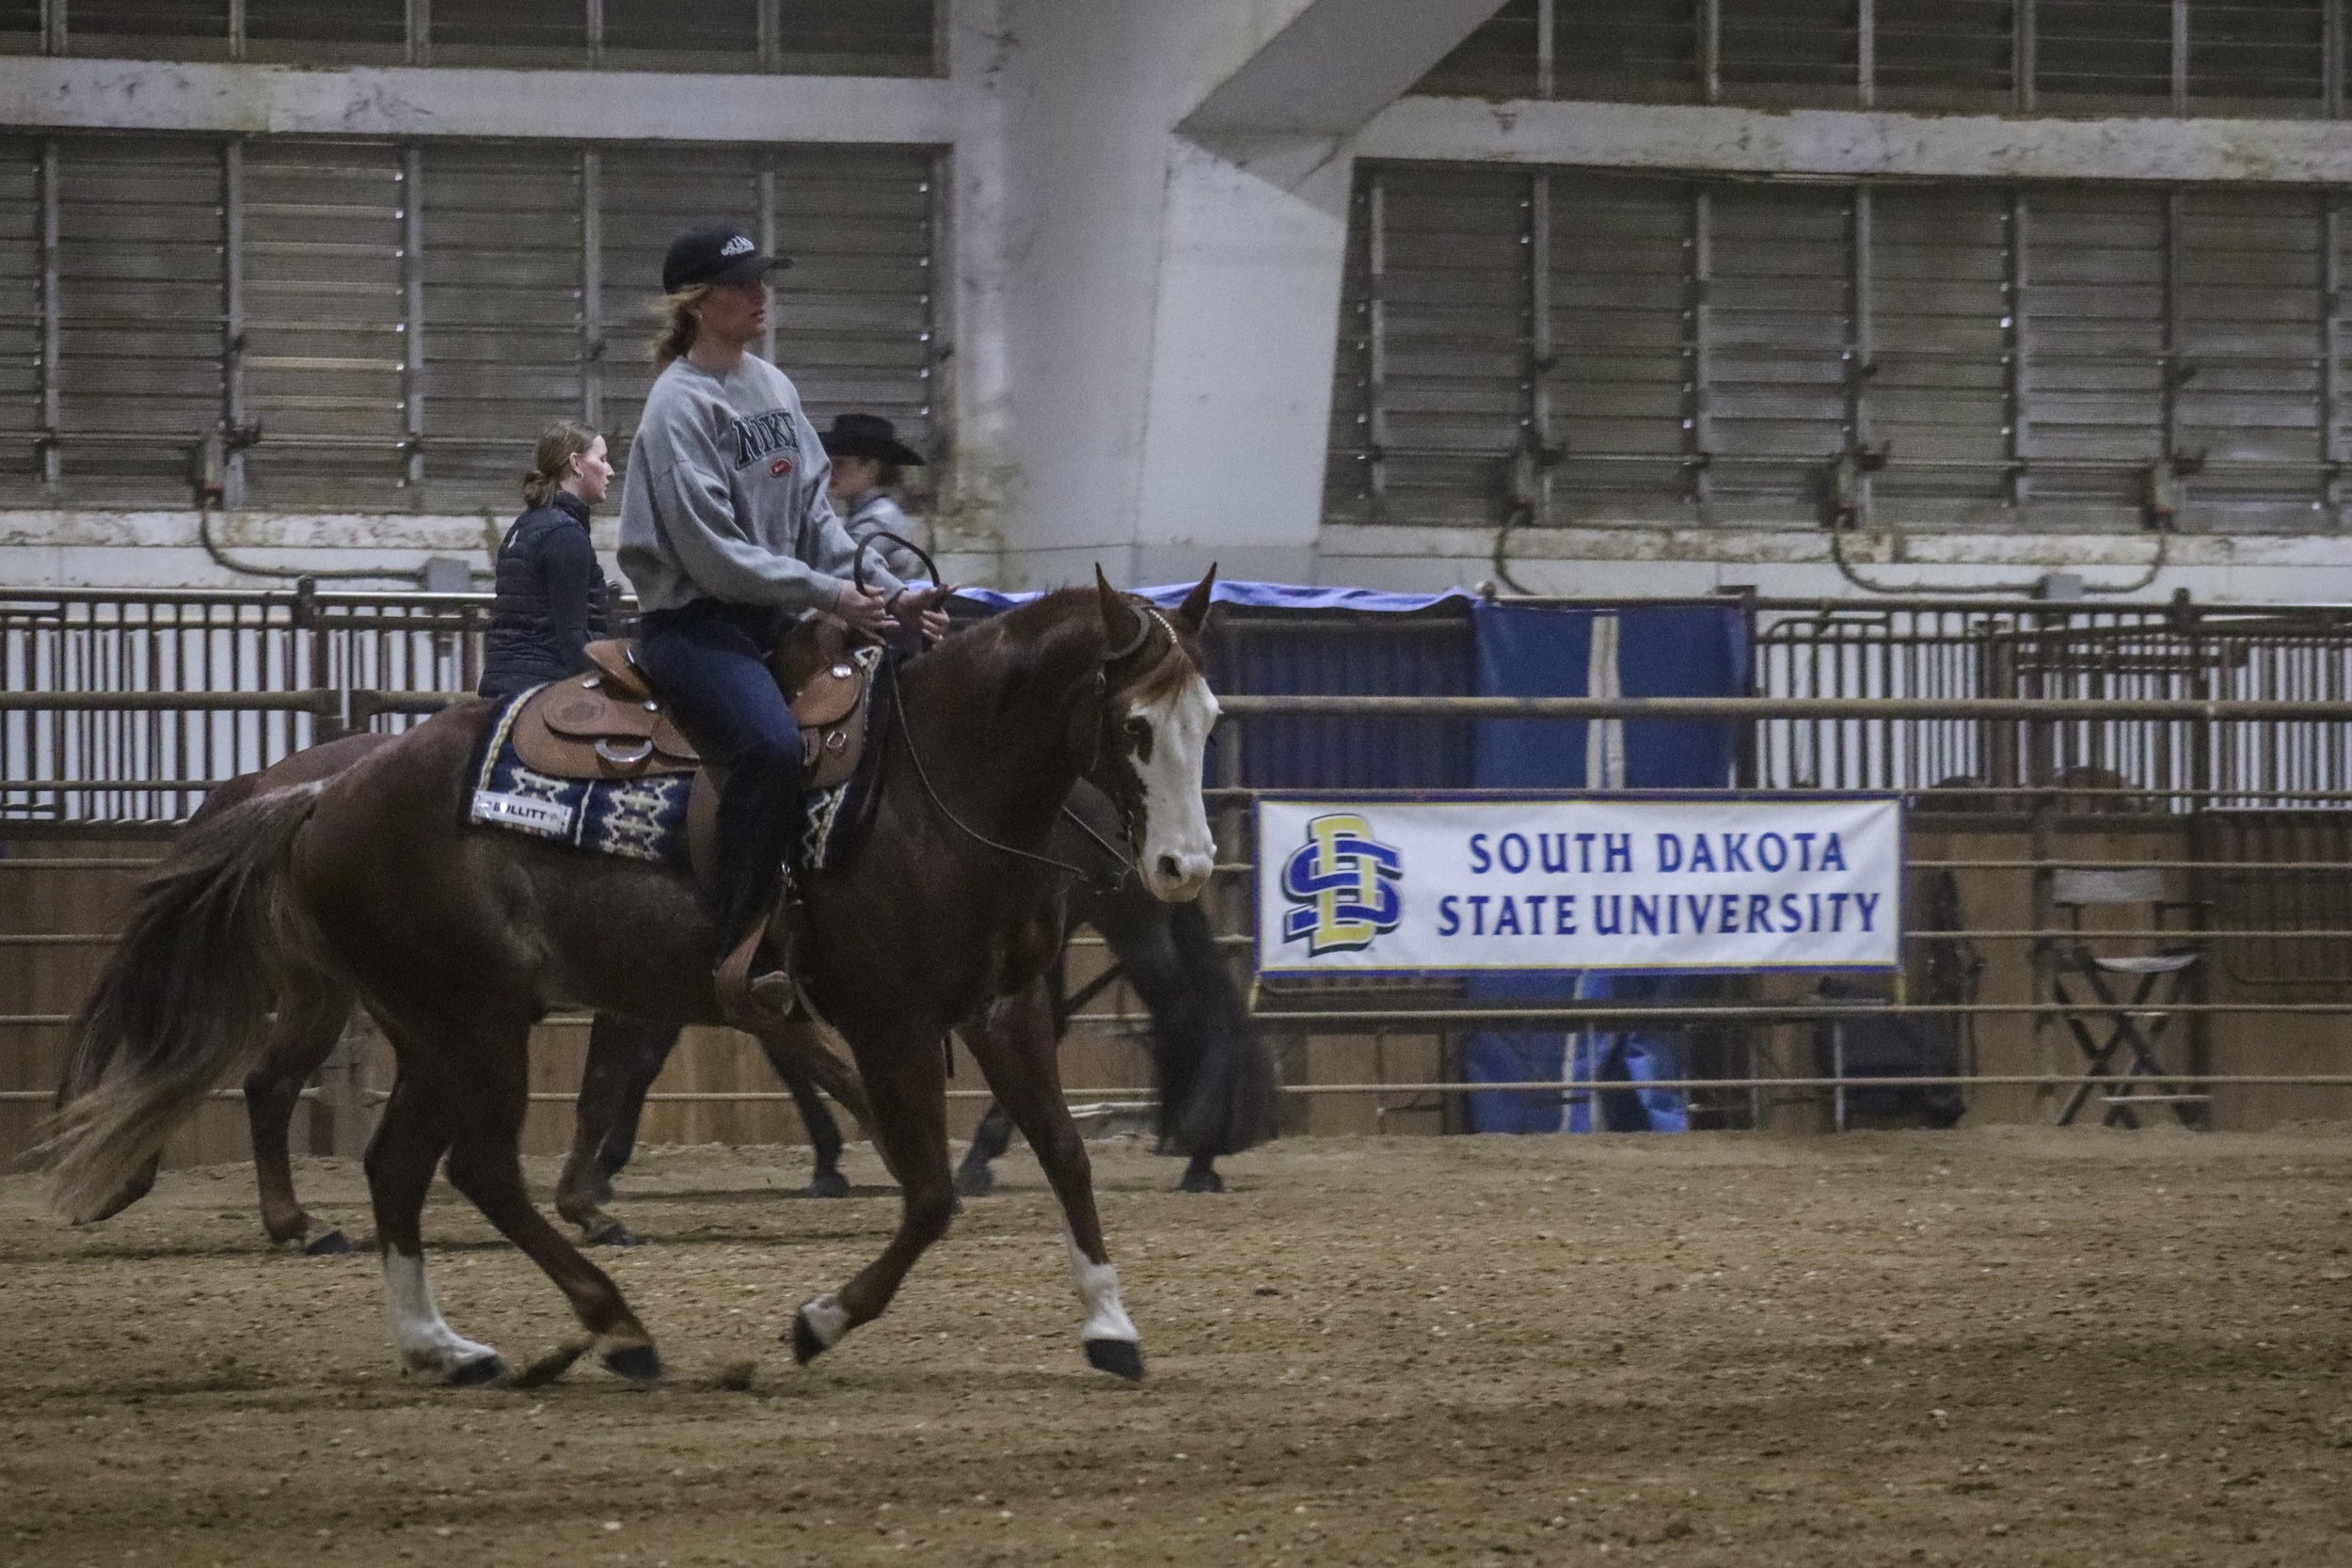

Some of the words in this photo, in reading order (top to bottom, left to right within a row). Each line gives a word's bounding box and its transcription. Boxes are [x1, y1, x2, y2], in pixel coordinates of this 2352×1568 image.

[1470, 832, 1632, 874] SOUTH
[1658, 832, 1847, 873] DAKOTA
[1438, 895, 1577, 937] STATE
[1594, 893, 1880, 936] UNIVERSITY
